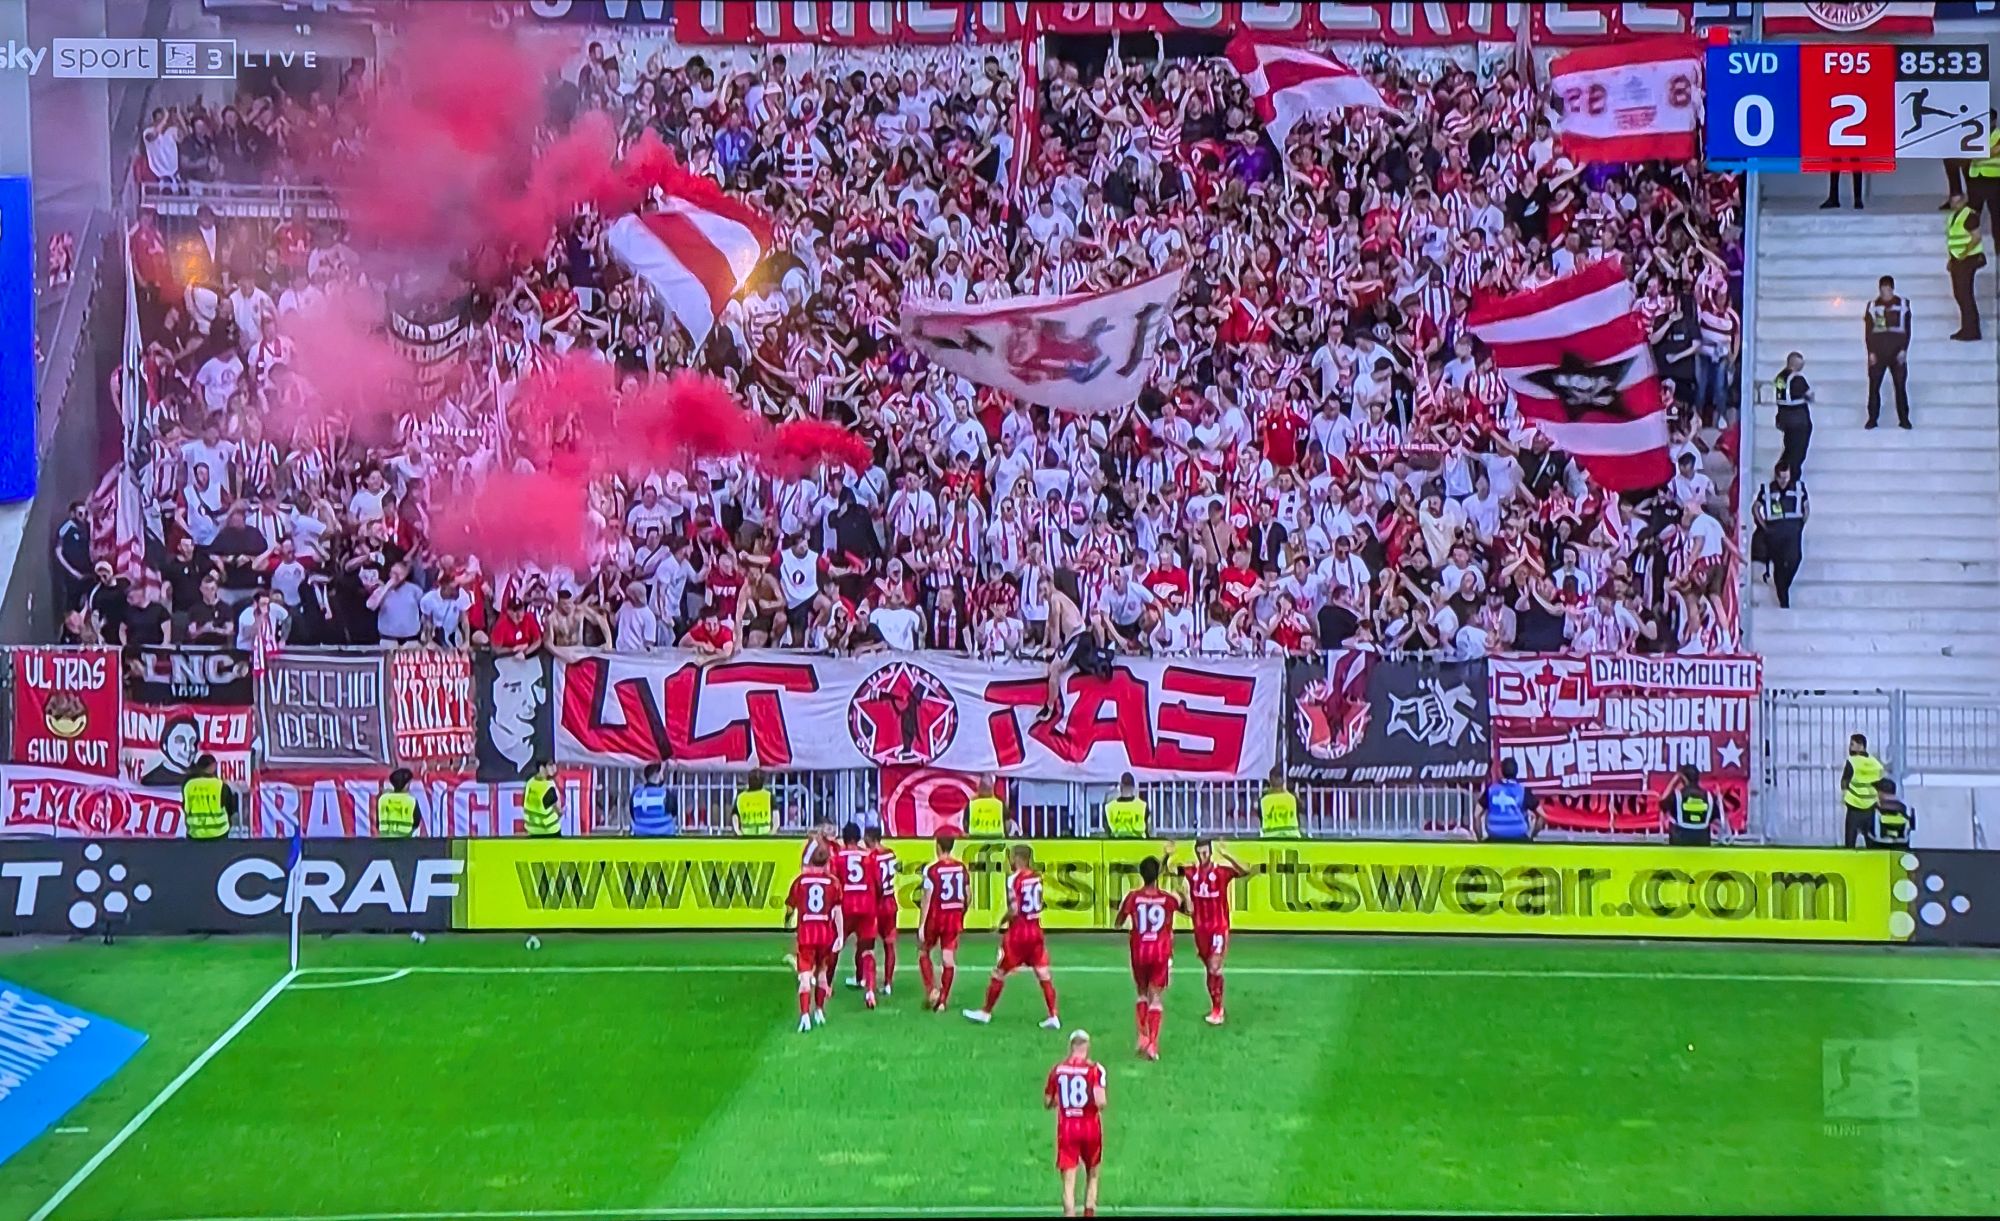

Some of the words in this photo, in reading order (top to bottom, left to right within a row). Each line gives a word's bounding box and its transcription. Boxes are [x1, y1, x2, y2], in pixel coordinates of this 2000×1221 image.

[25, 654, 105, 690] ULTRAS
[267, 669, 376, 707] VECCHIO
[277, 712, 370, 750] IDEALE
[1604, 697, 1747, 734] DISSIDENTI
[216, 858, 465, 915] CRAF
[847, 855, 865, 883] 5
[940, 872, 964, 901] 31
[808, 884, 825, 914] 8
[1021, 884, 1042, 913] 30
[1136, 904, 1166, 934] 19
[1057, 1074, 1088, 1109] 18
